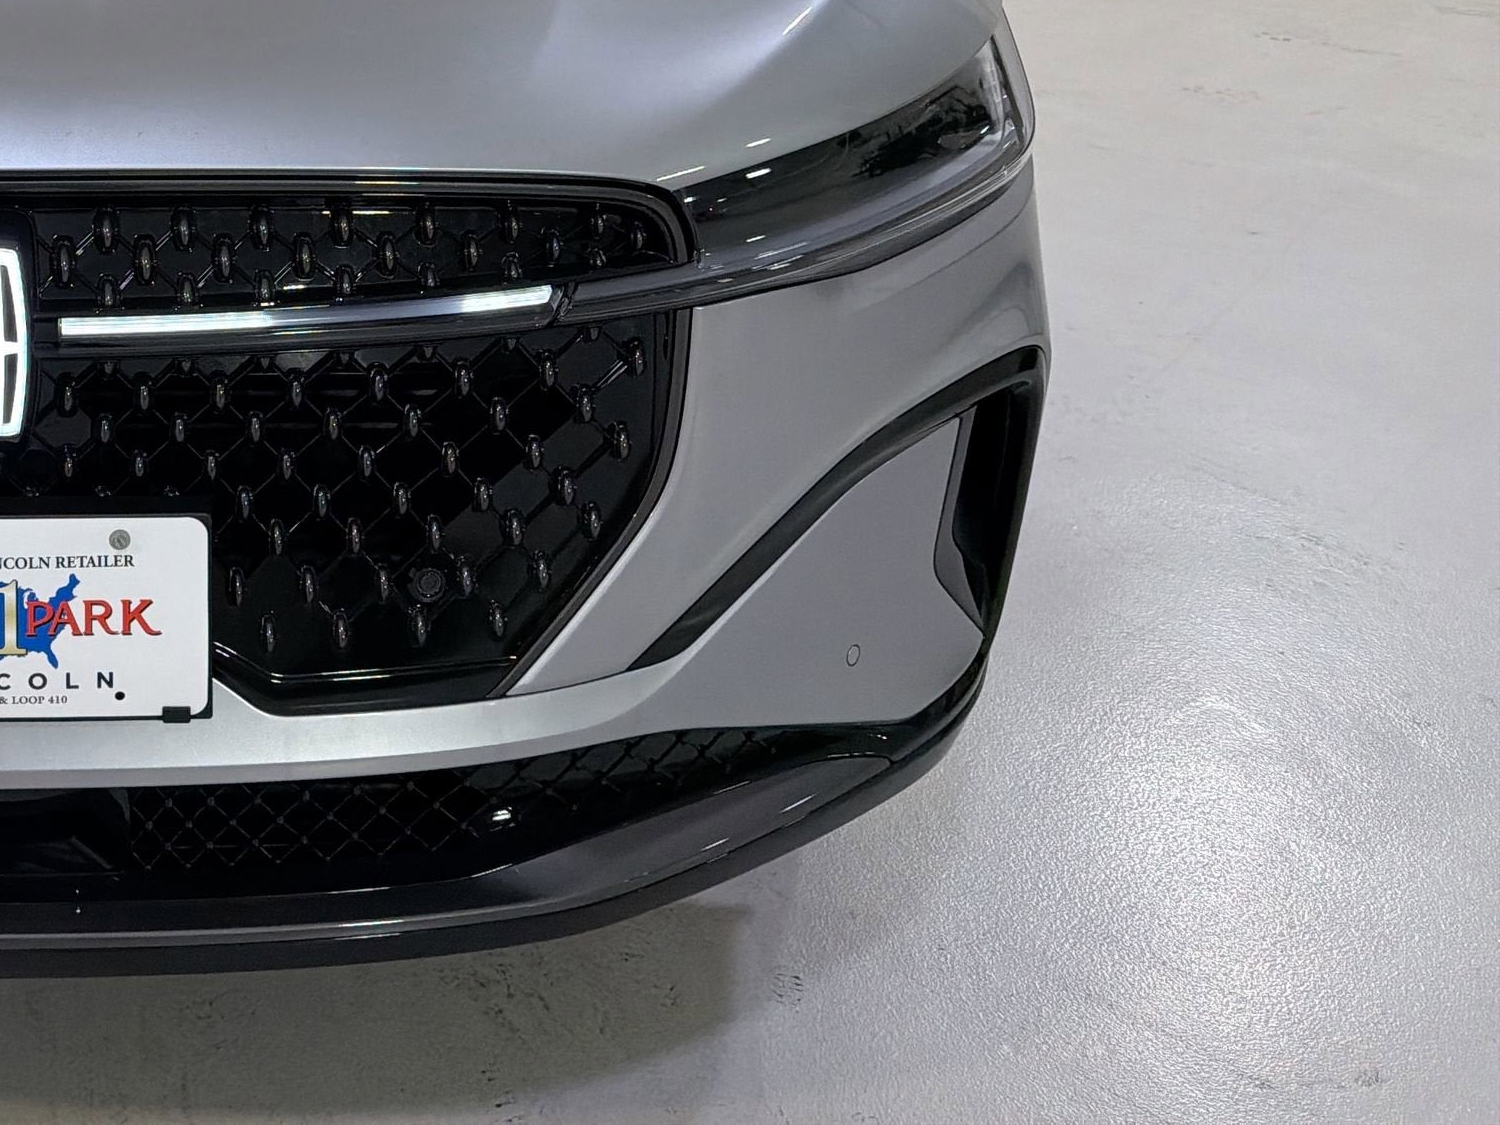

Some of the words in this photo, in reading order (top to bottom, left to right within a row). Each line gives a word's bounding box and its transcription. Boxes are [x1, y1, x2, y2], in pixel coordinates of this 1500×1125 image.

[56, 555, 135, 569] RETAILER
[26, 598, 162, 637] PARK
[0, 696, 8, 705] &
[11, 696, 45, 705] LOOP
[47, 695, 68, 705] 410
